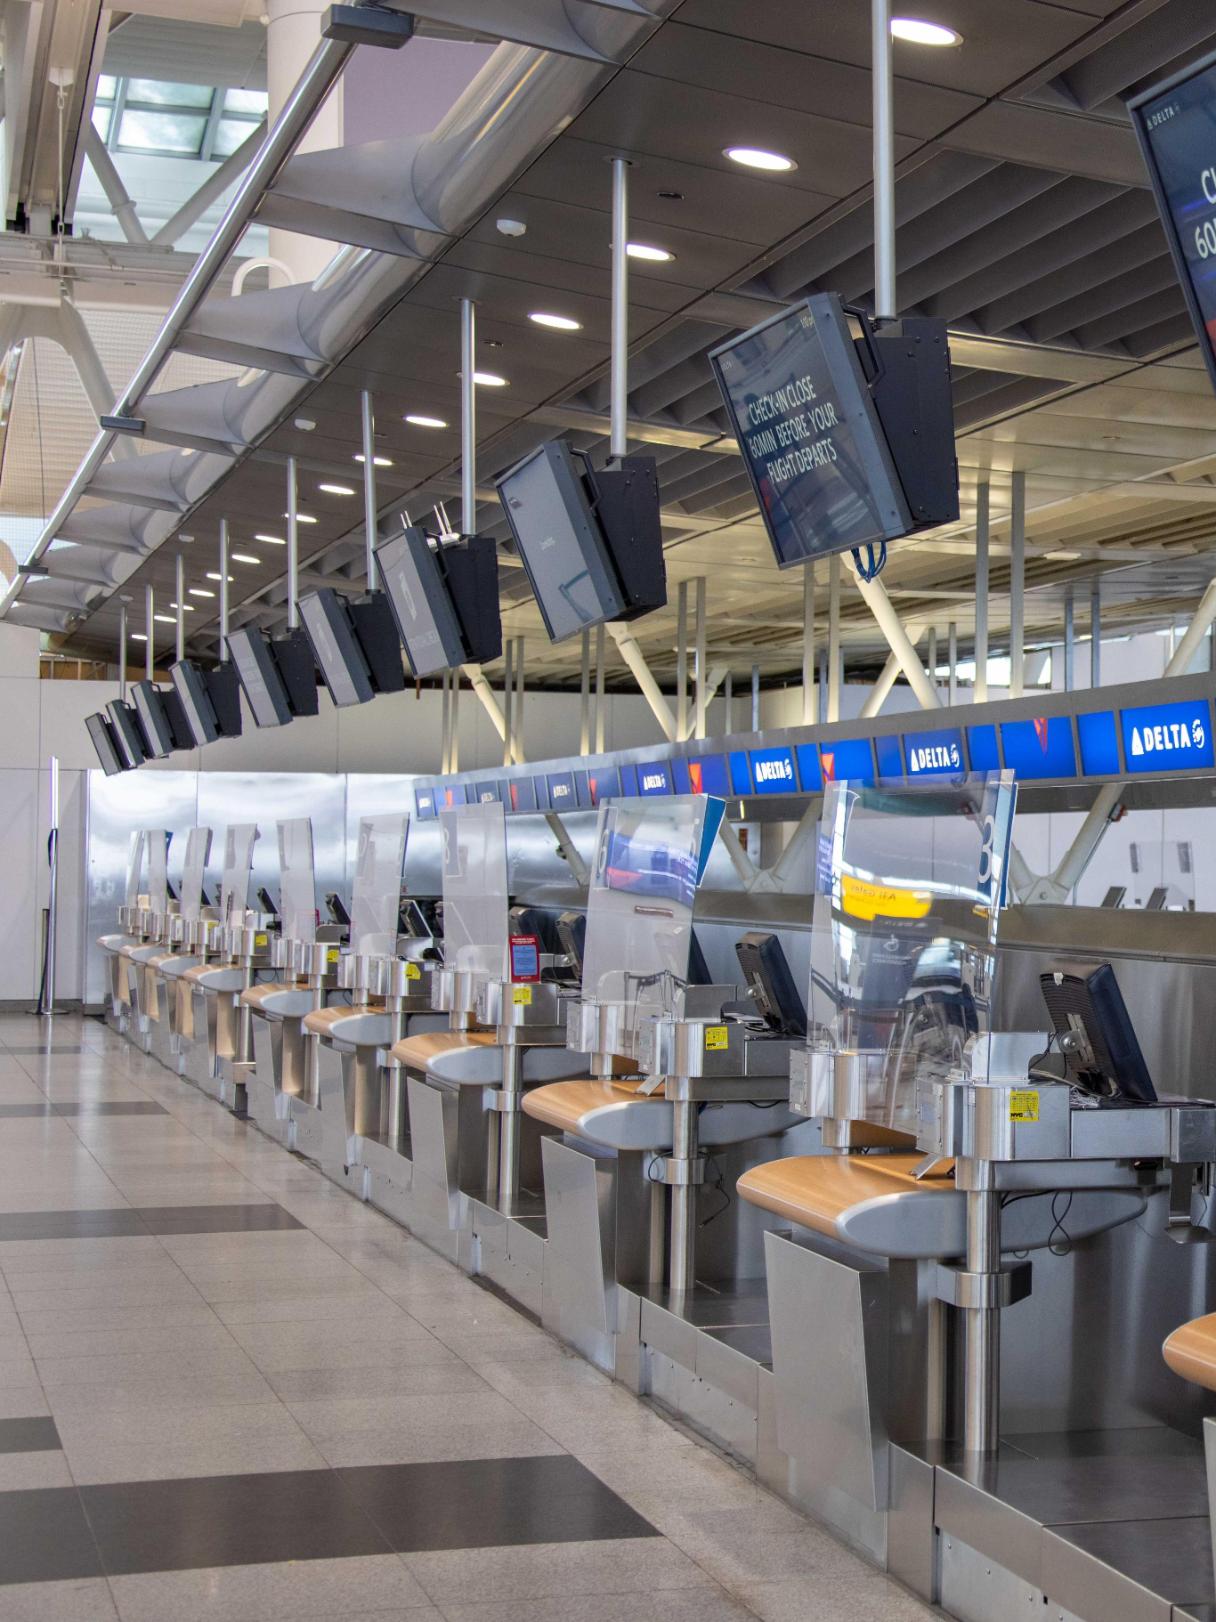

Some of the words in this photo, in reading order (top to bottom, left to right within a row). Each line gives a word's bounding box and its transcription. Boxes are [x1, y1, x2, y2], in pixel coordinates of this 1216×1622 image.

[1152, 106, 1175, 126] DELTA
[749, 389, 789, 425] CHECK-IN
[786, 375, 816, 408] CLOSE
[749, 428, 778, 459] 60MIN
[776, 414, 810, 447] BEFORE
[808, 402, 839, 432] YOUR
[766, 453, 797, 484] FLIGHT
[794, 438, 837, 473] DEPARTS
[1143, 723, 1191, 752] DELTA
[760, 760, 786, 780] DELTA
[918, 746, 951, 768] DELTA
